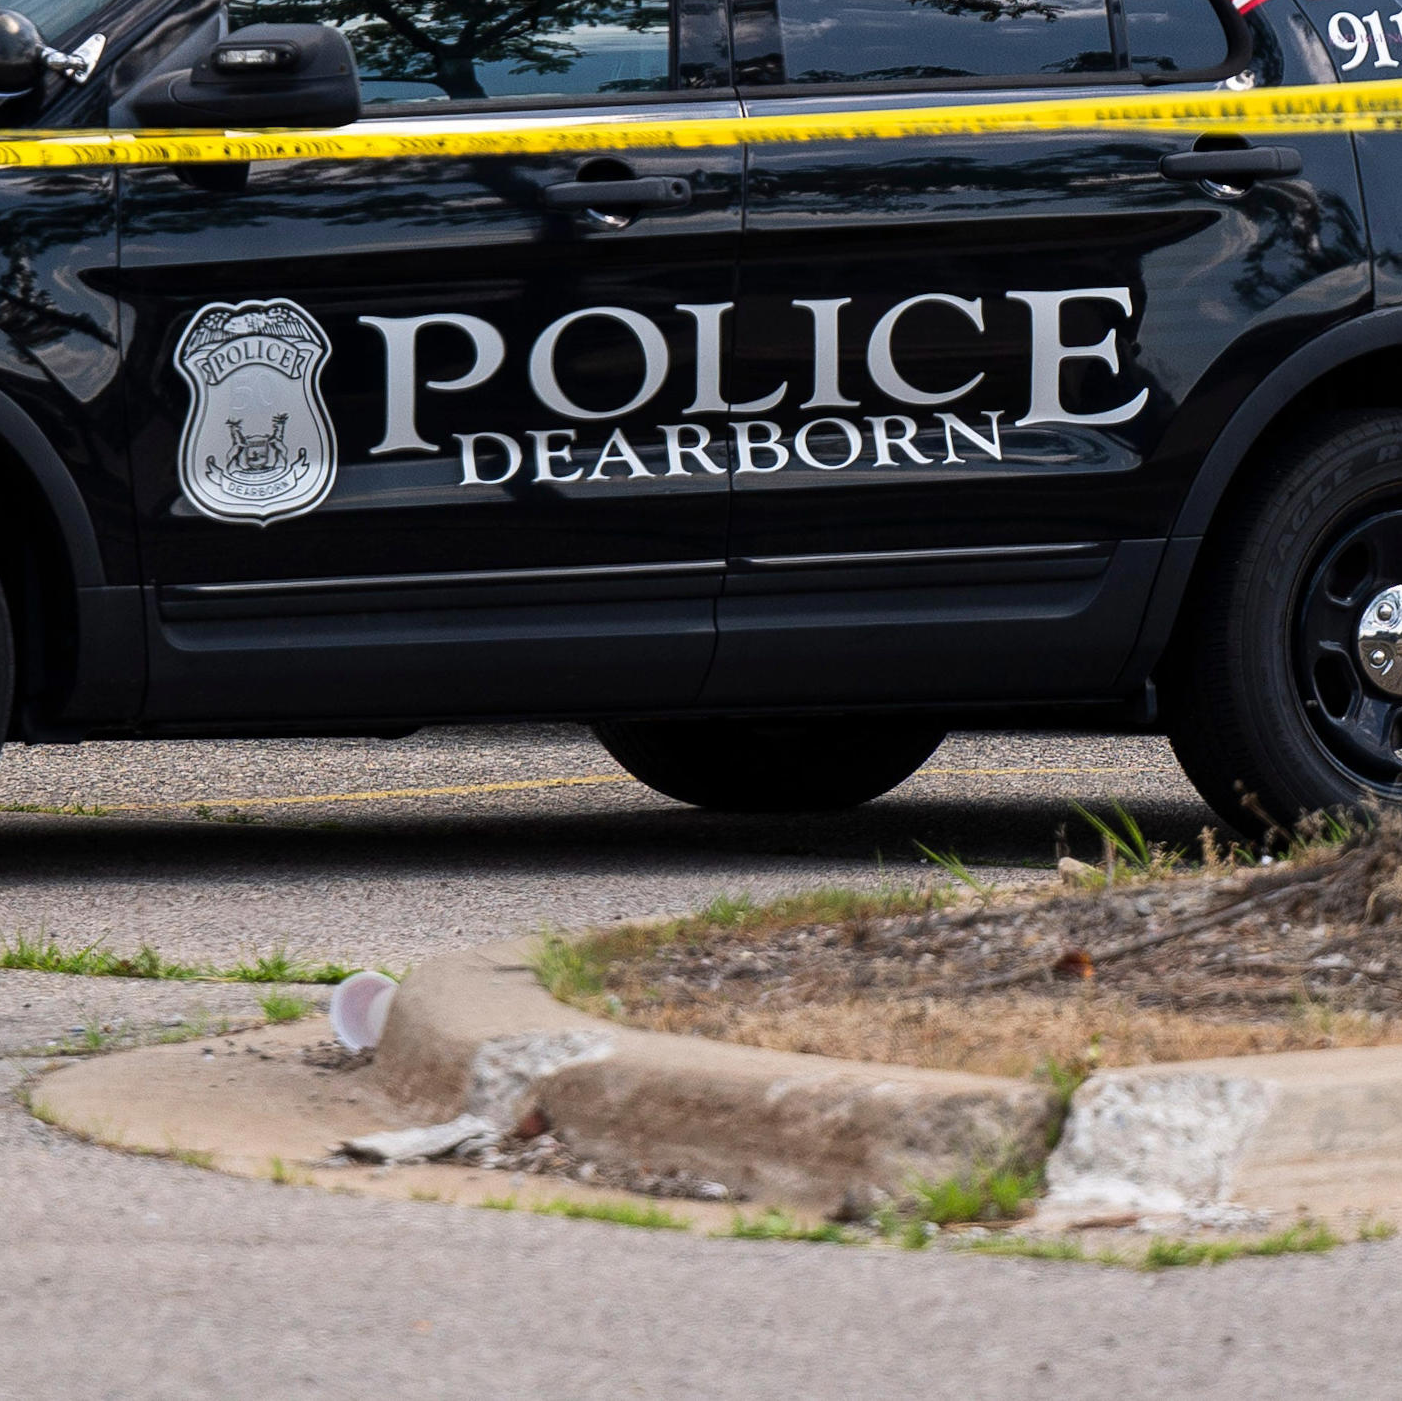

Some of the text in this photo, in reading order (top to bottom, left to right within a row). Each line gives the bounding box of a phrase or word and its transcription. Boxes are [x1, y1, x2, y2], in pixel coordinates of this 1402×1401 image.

[213, 339, 294, 373] POLICE
[357, 286, 1150, 456] POLICE
[451, 409, 1006, 487] DEARBORN
[228, 479, 290, 497] DEARBORN
[1266, 460, 1355, 591] EAGLE
